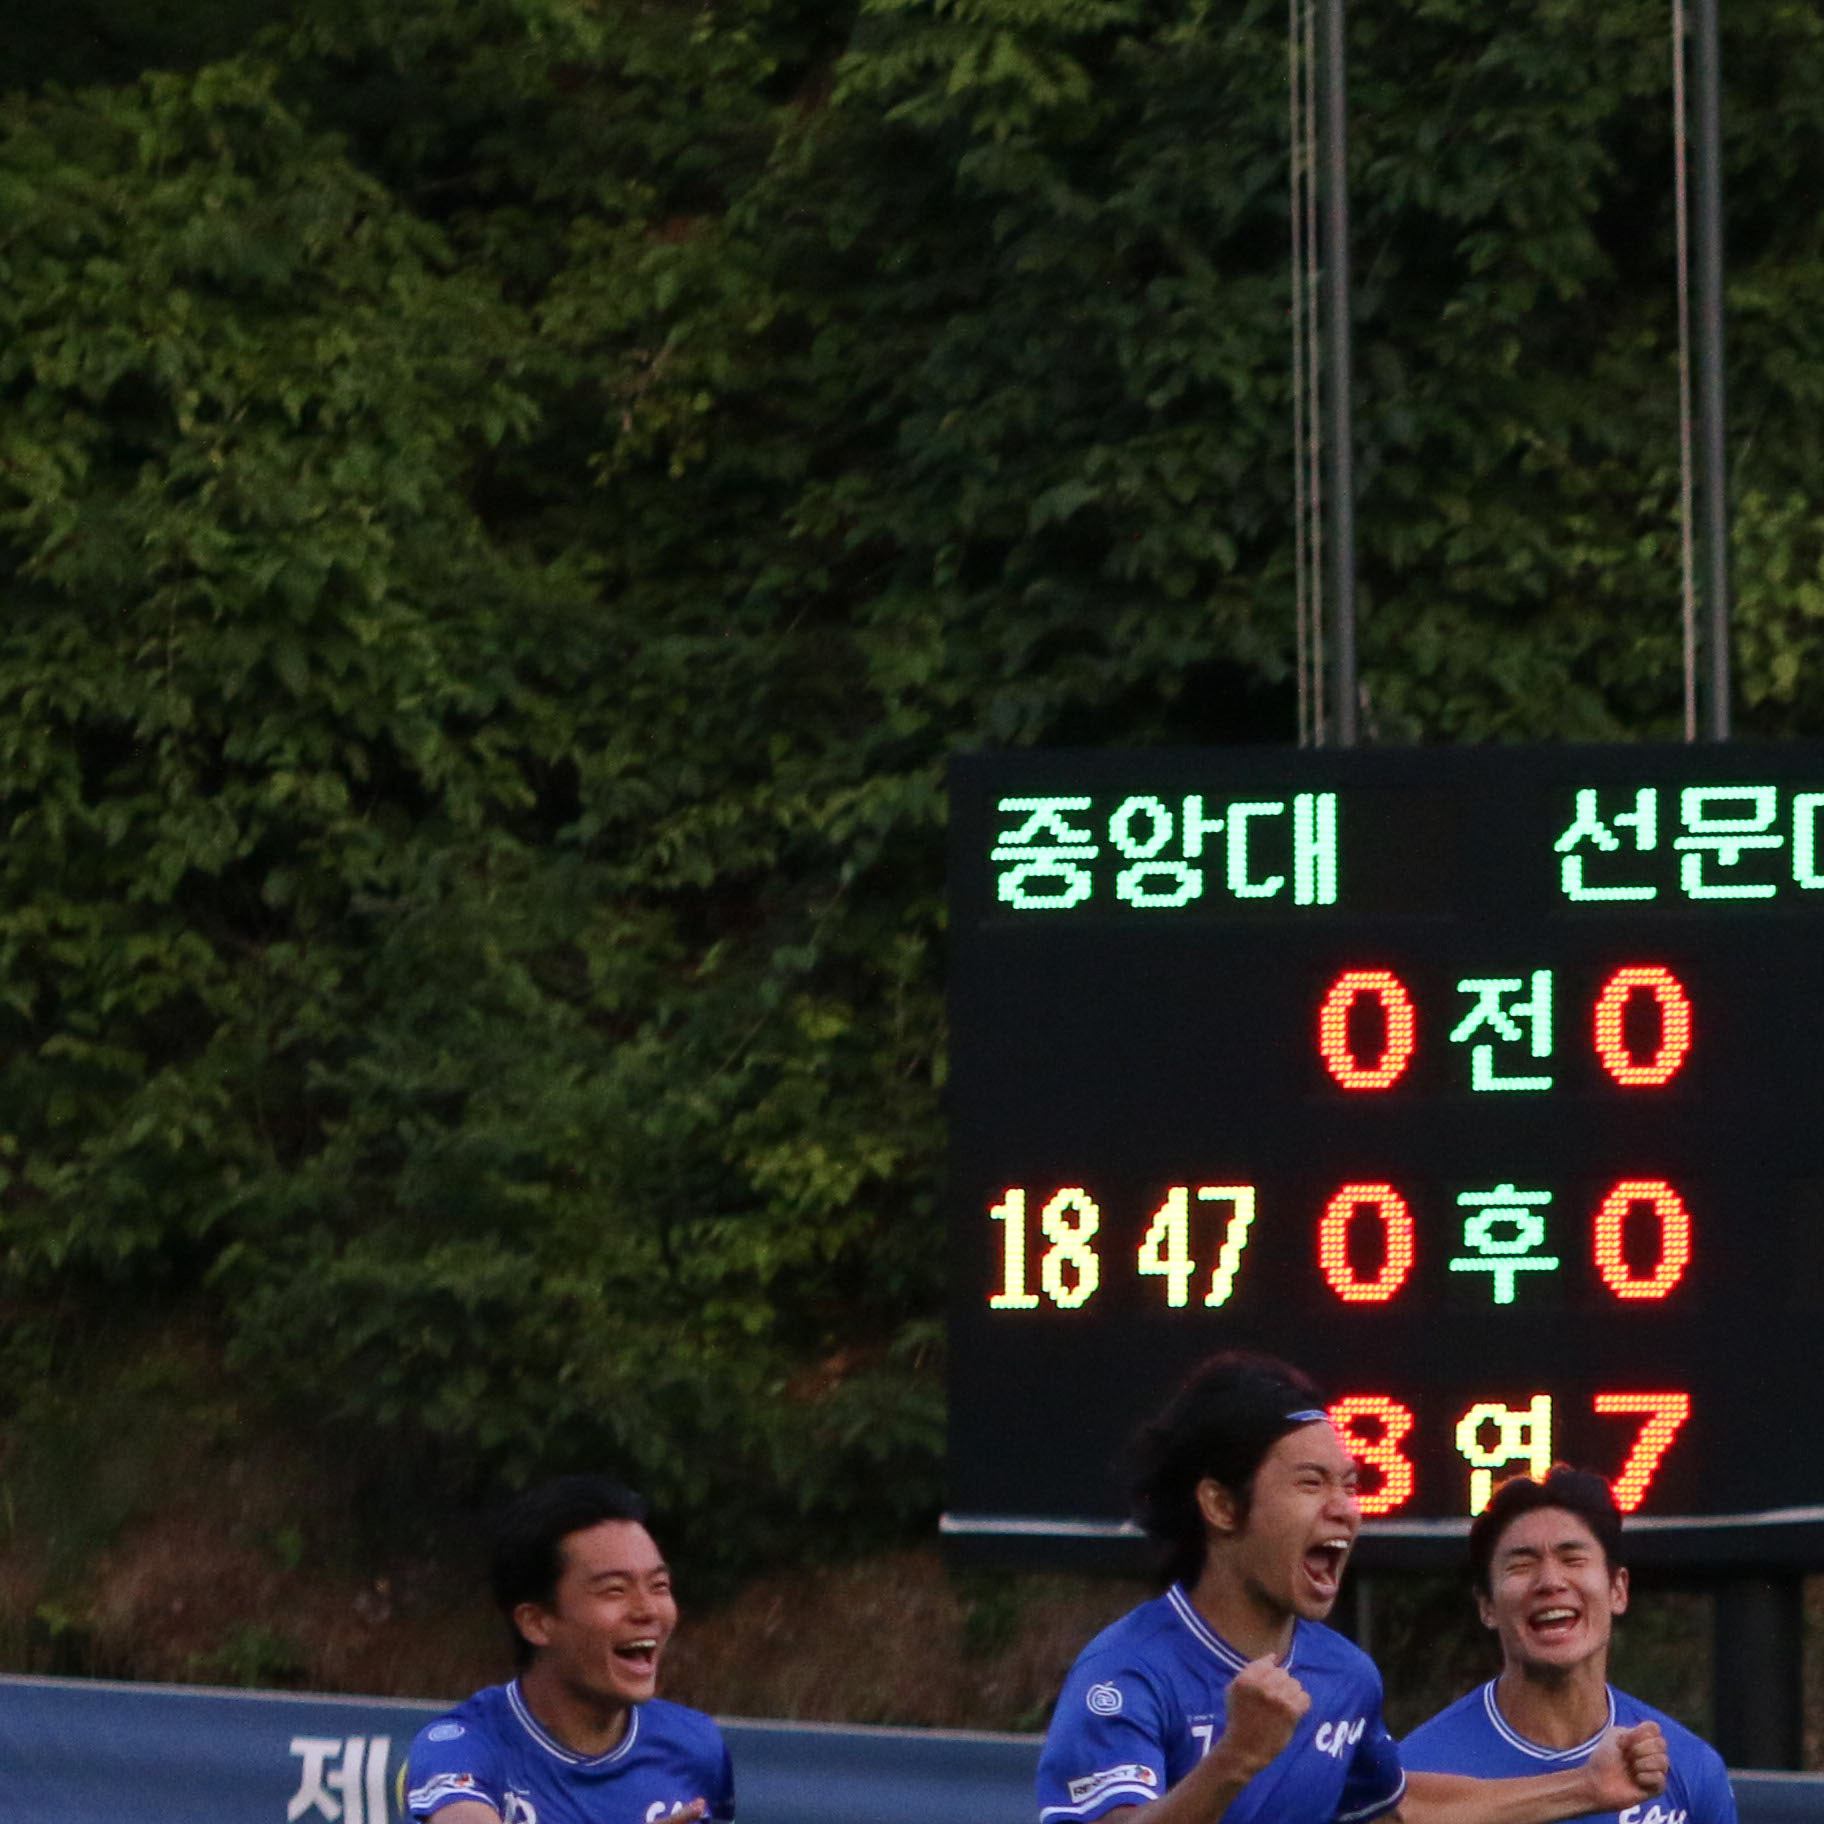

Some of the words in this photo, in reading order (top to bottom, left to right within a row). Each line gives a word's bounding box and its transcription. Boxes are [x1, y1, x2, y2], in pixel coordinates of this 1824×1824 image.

[991, 793, 1336, 909] 중앙대
[1319, 970, 1416, 1090] 0
[1450, 970, 1552, 1090] 전
[1594, 966, 1692, 1086] 0
[990, 1188, 1098, 1308] 18
[1138, 1186, 1254, 1307] 47
[1318, 1183, 1414, 1303] 0
[1450, 1184, 1558, 1303] 후
[1594, 1179, 1691, 1300] 0
[1594, 1393, 1690, 1513] 7
